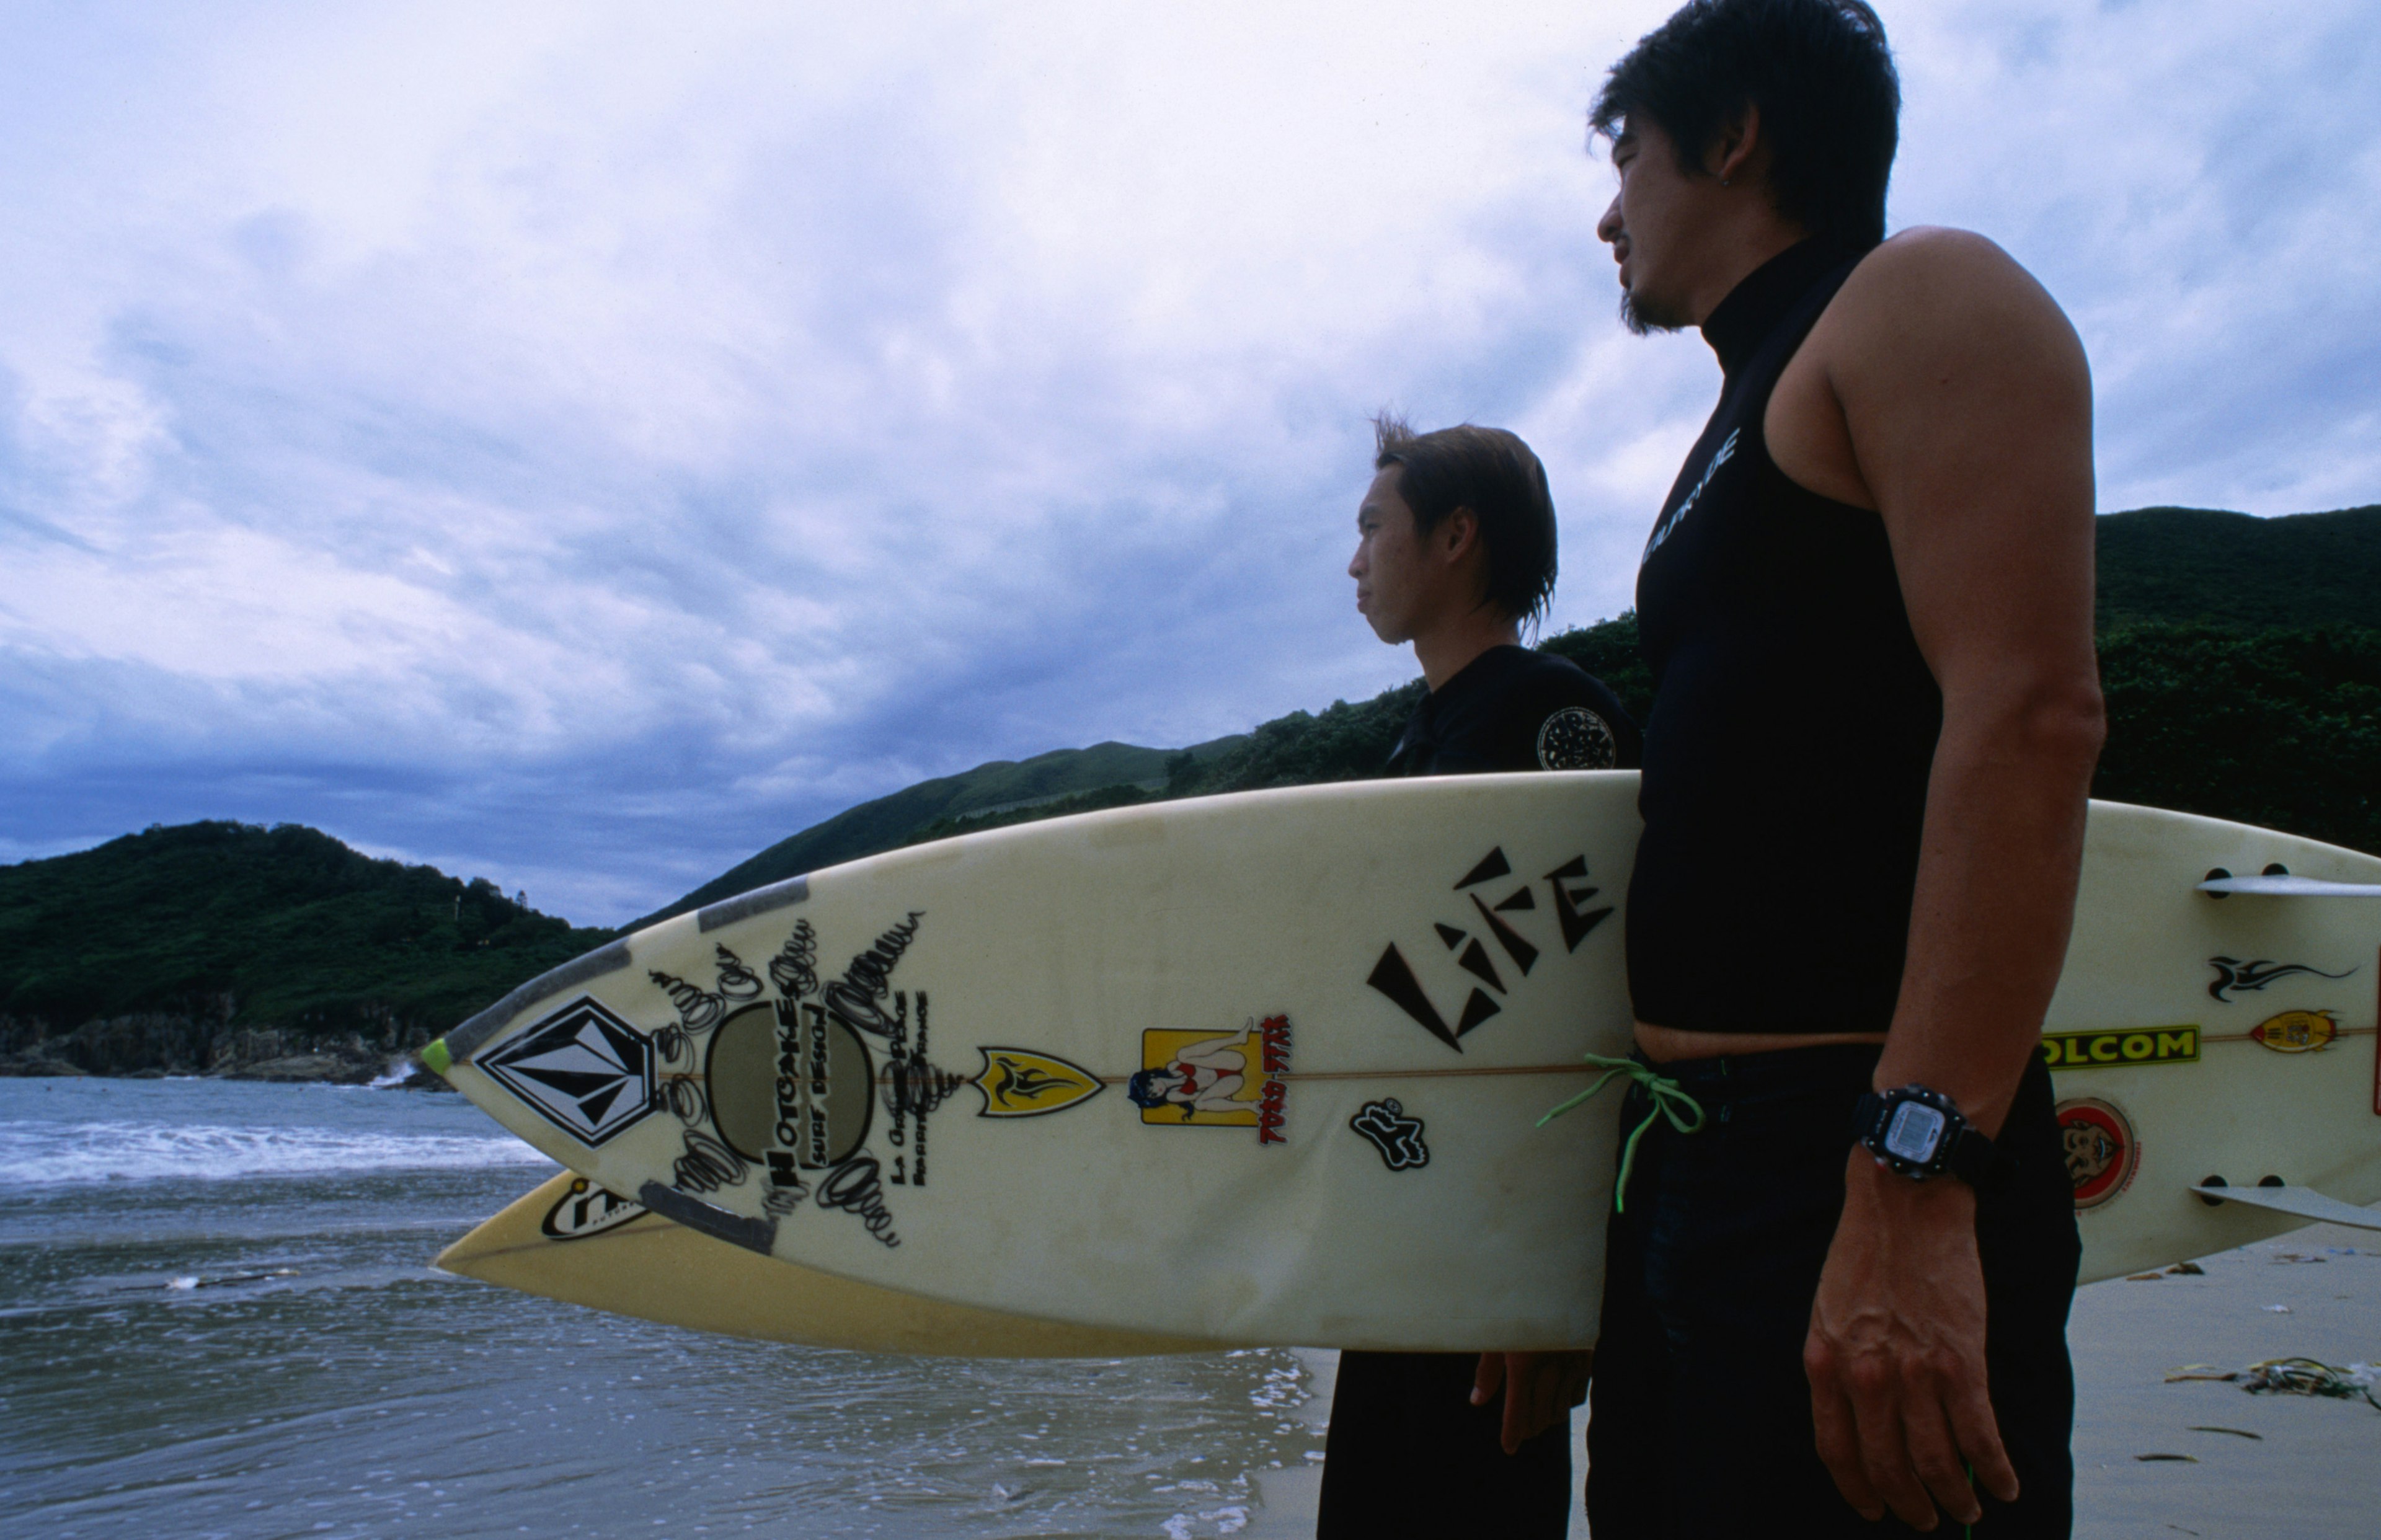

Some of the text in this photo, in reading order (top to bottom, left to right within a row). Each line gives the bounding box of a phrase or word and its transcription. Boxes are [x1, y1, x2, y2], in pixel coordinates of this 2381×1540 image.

[809, 1004, 828, 1166] SURF DESIGN
[2041, 1030, 2194, 1065] OLCOM
